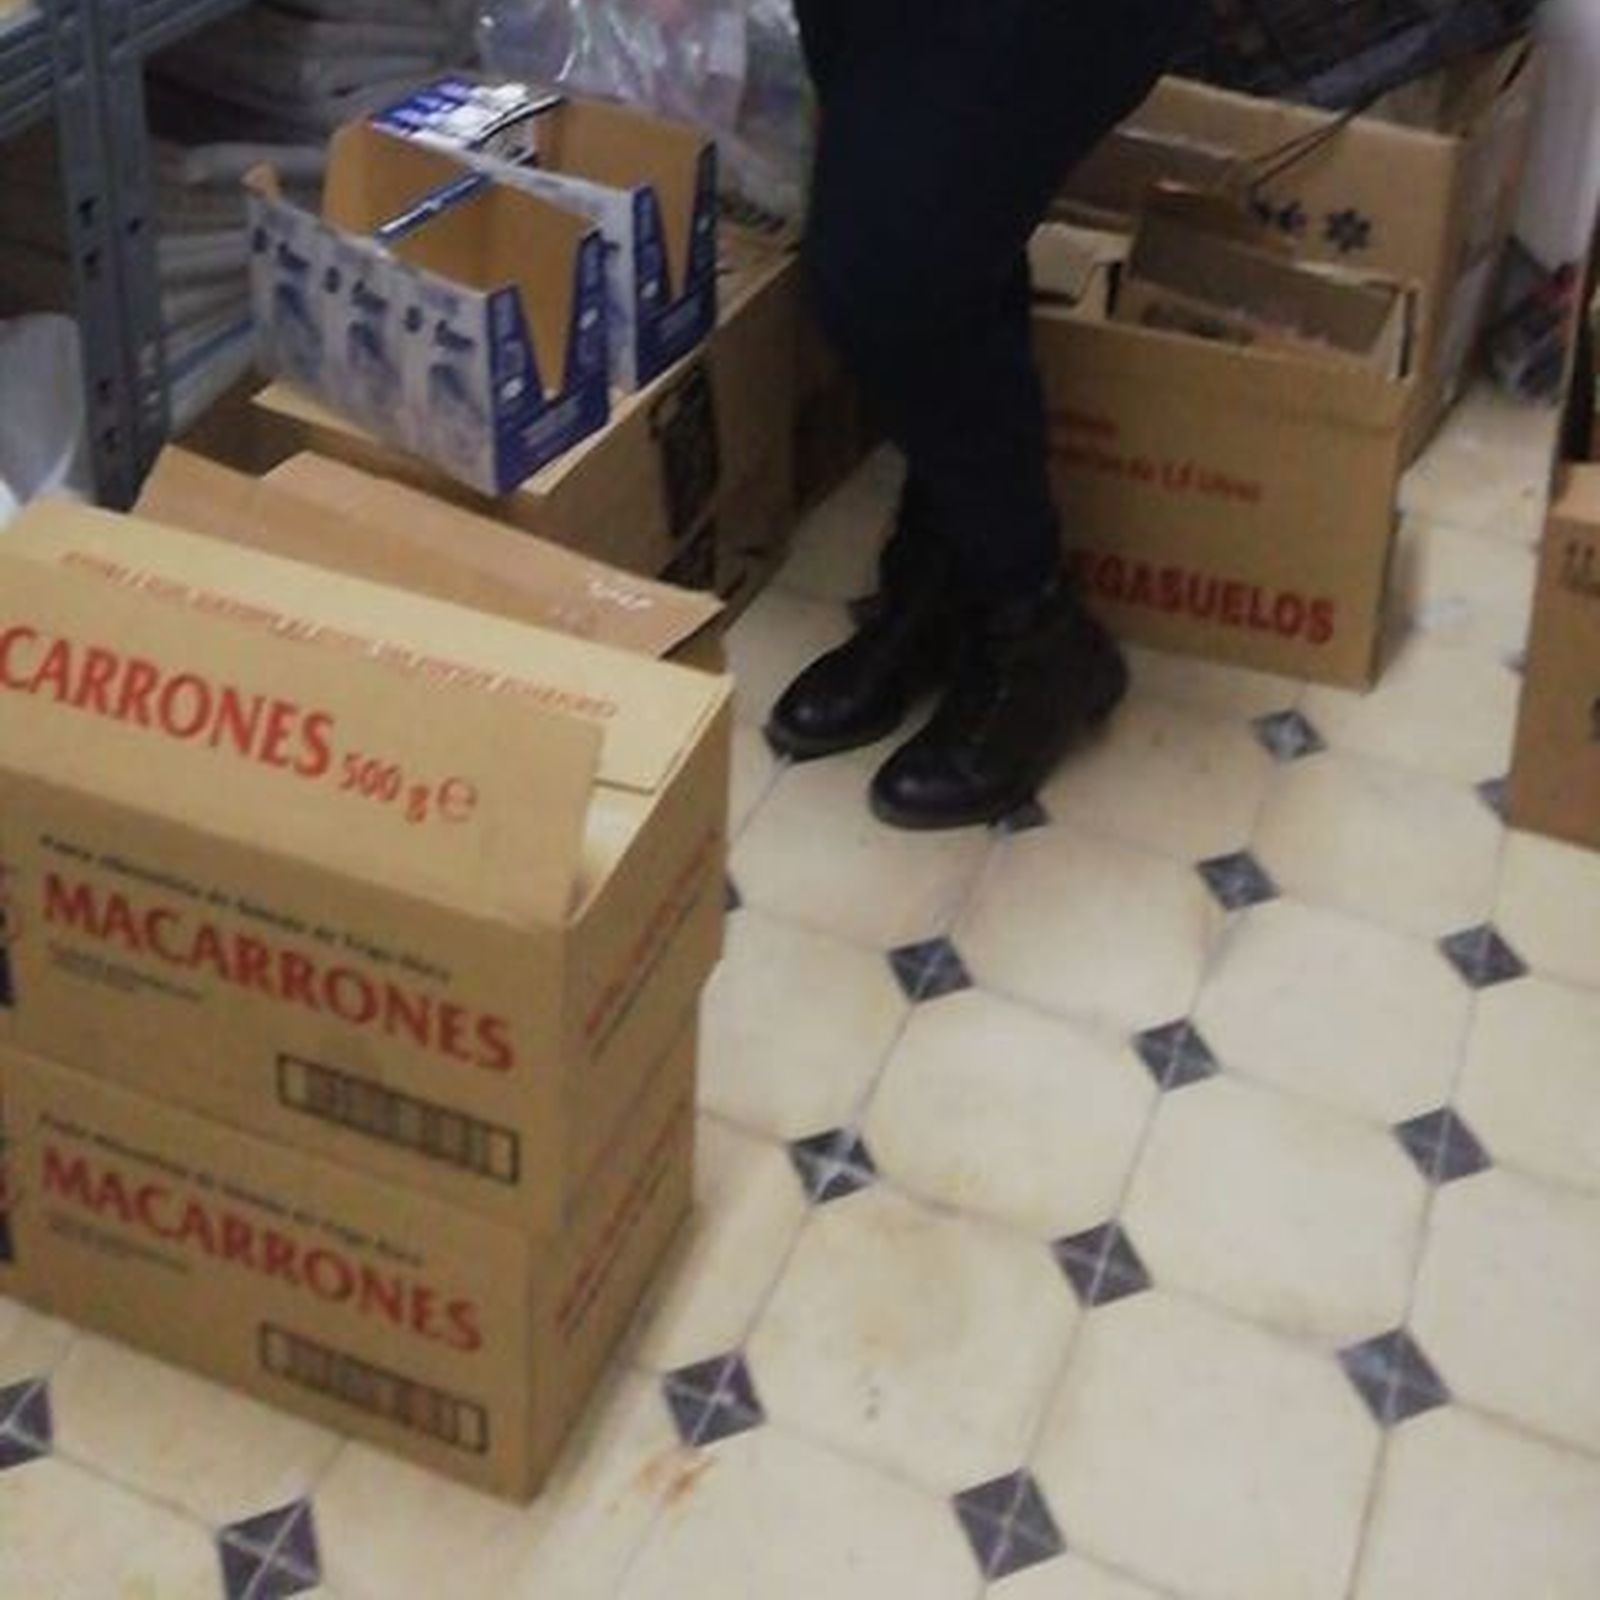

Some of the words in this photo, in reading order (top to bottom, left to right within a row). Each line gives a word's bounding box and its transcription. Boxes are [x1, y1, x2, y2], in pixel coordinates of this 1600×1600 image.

[0, 627, 334, 777] CARRONES
[342, 752, 402, 802] 500
[404, 784, 430, 822] g
[44, 874, 514, 1071] MACARRONES
[41, 1147, 482, 1351] MACARRONES
